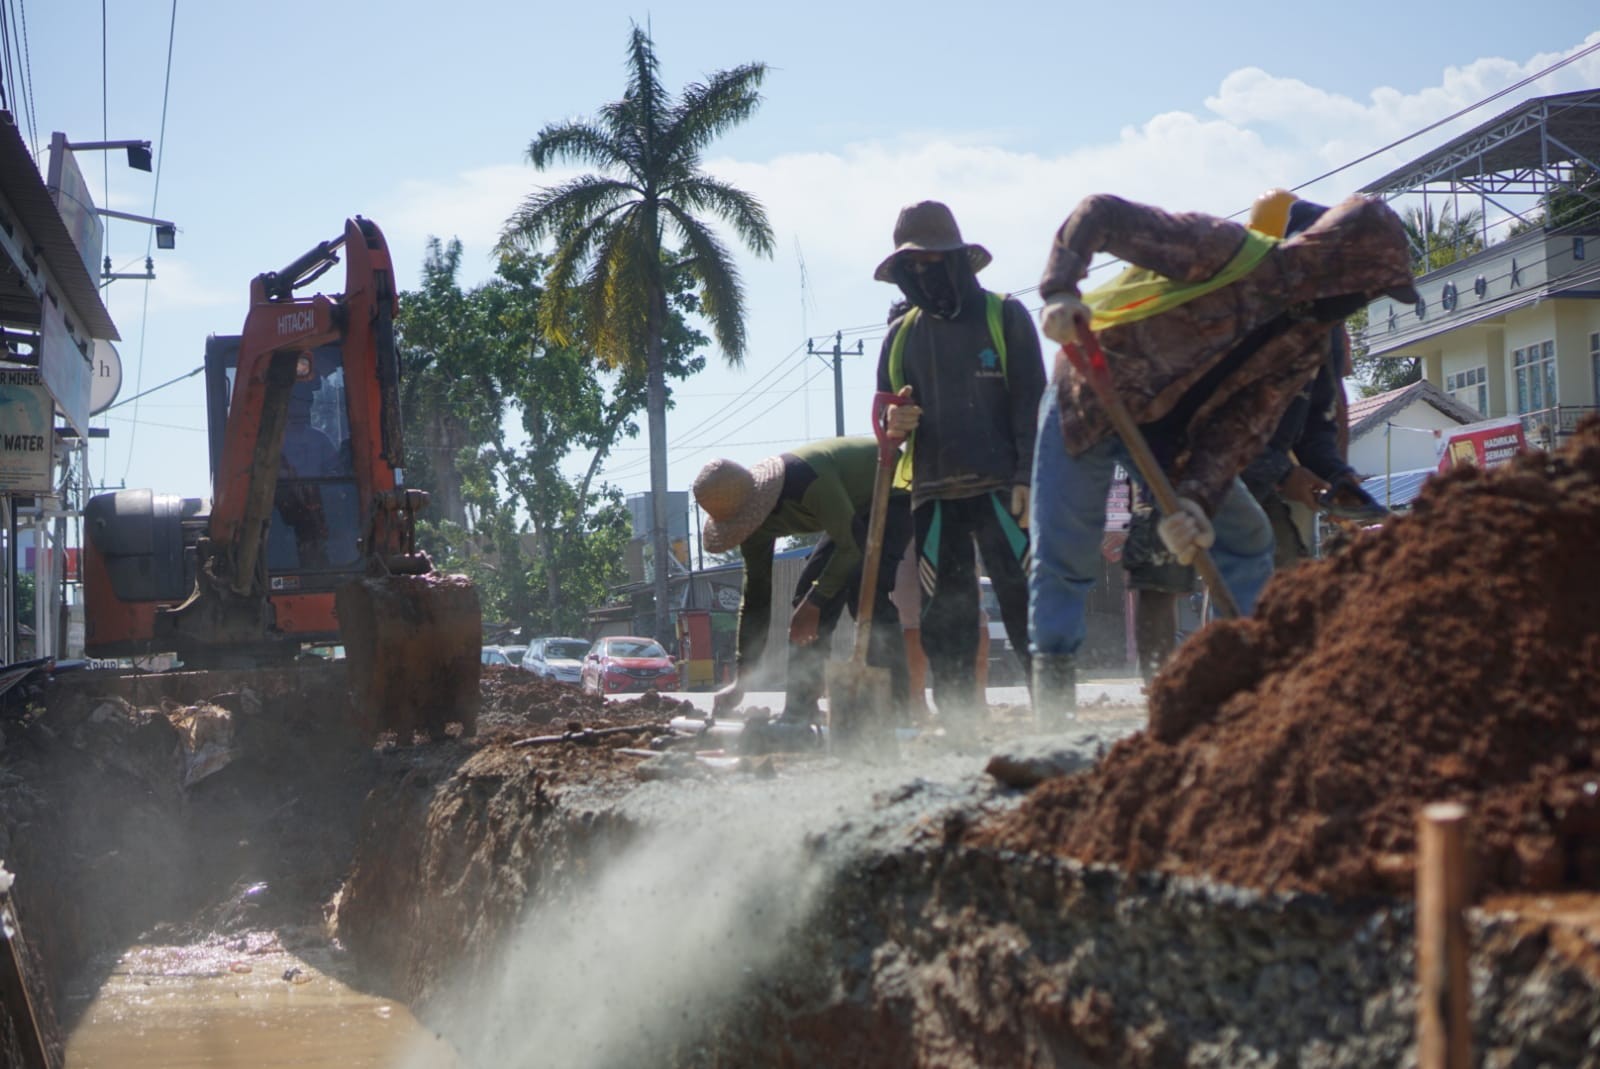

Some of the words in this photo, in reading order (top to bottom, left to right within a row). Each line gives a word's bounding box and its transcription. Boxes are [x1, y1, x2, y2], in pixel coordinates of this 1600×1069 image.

[277, 309, 315, 335] HITACHI
[8, 372, 42, 386] MINER
[4, 435, 44, 452] WATER
